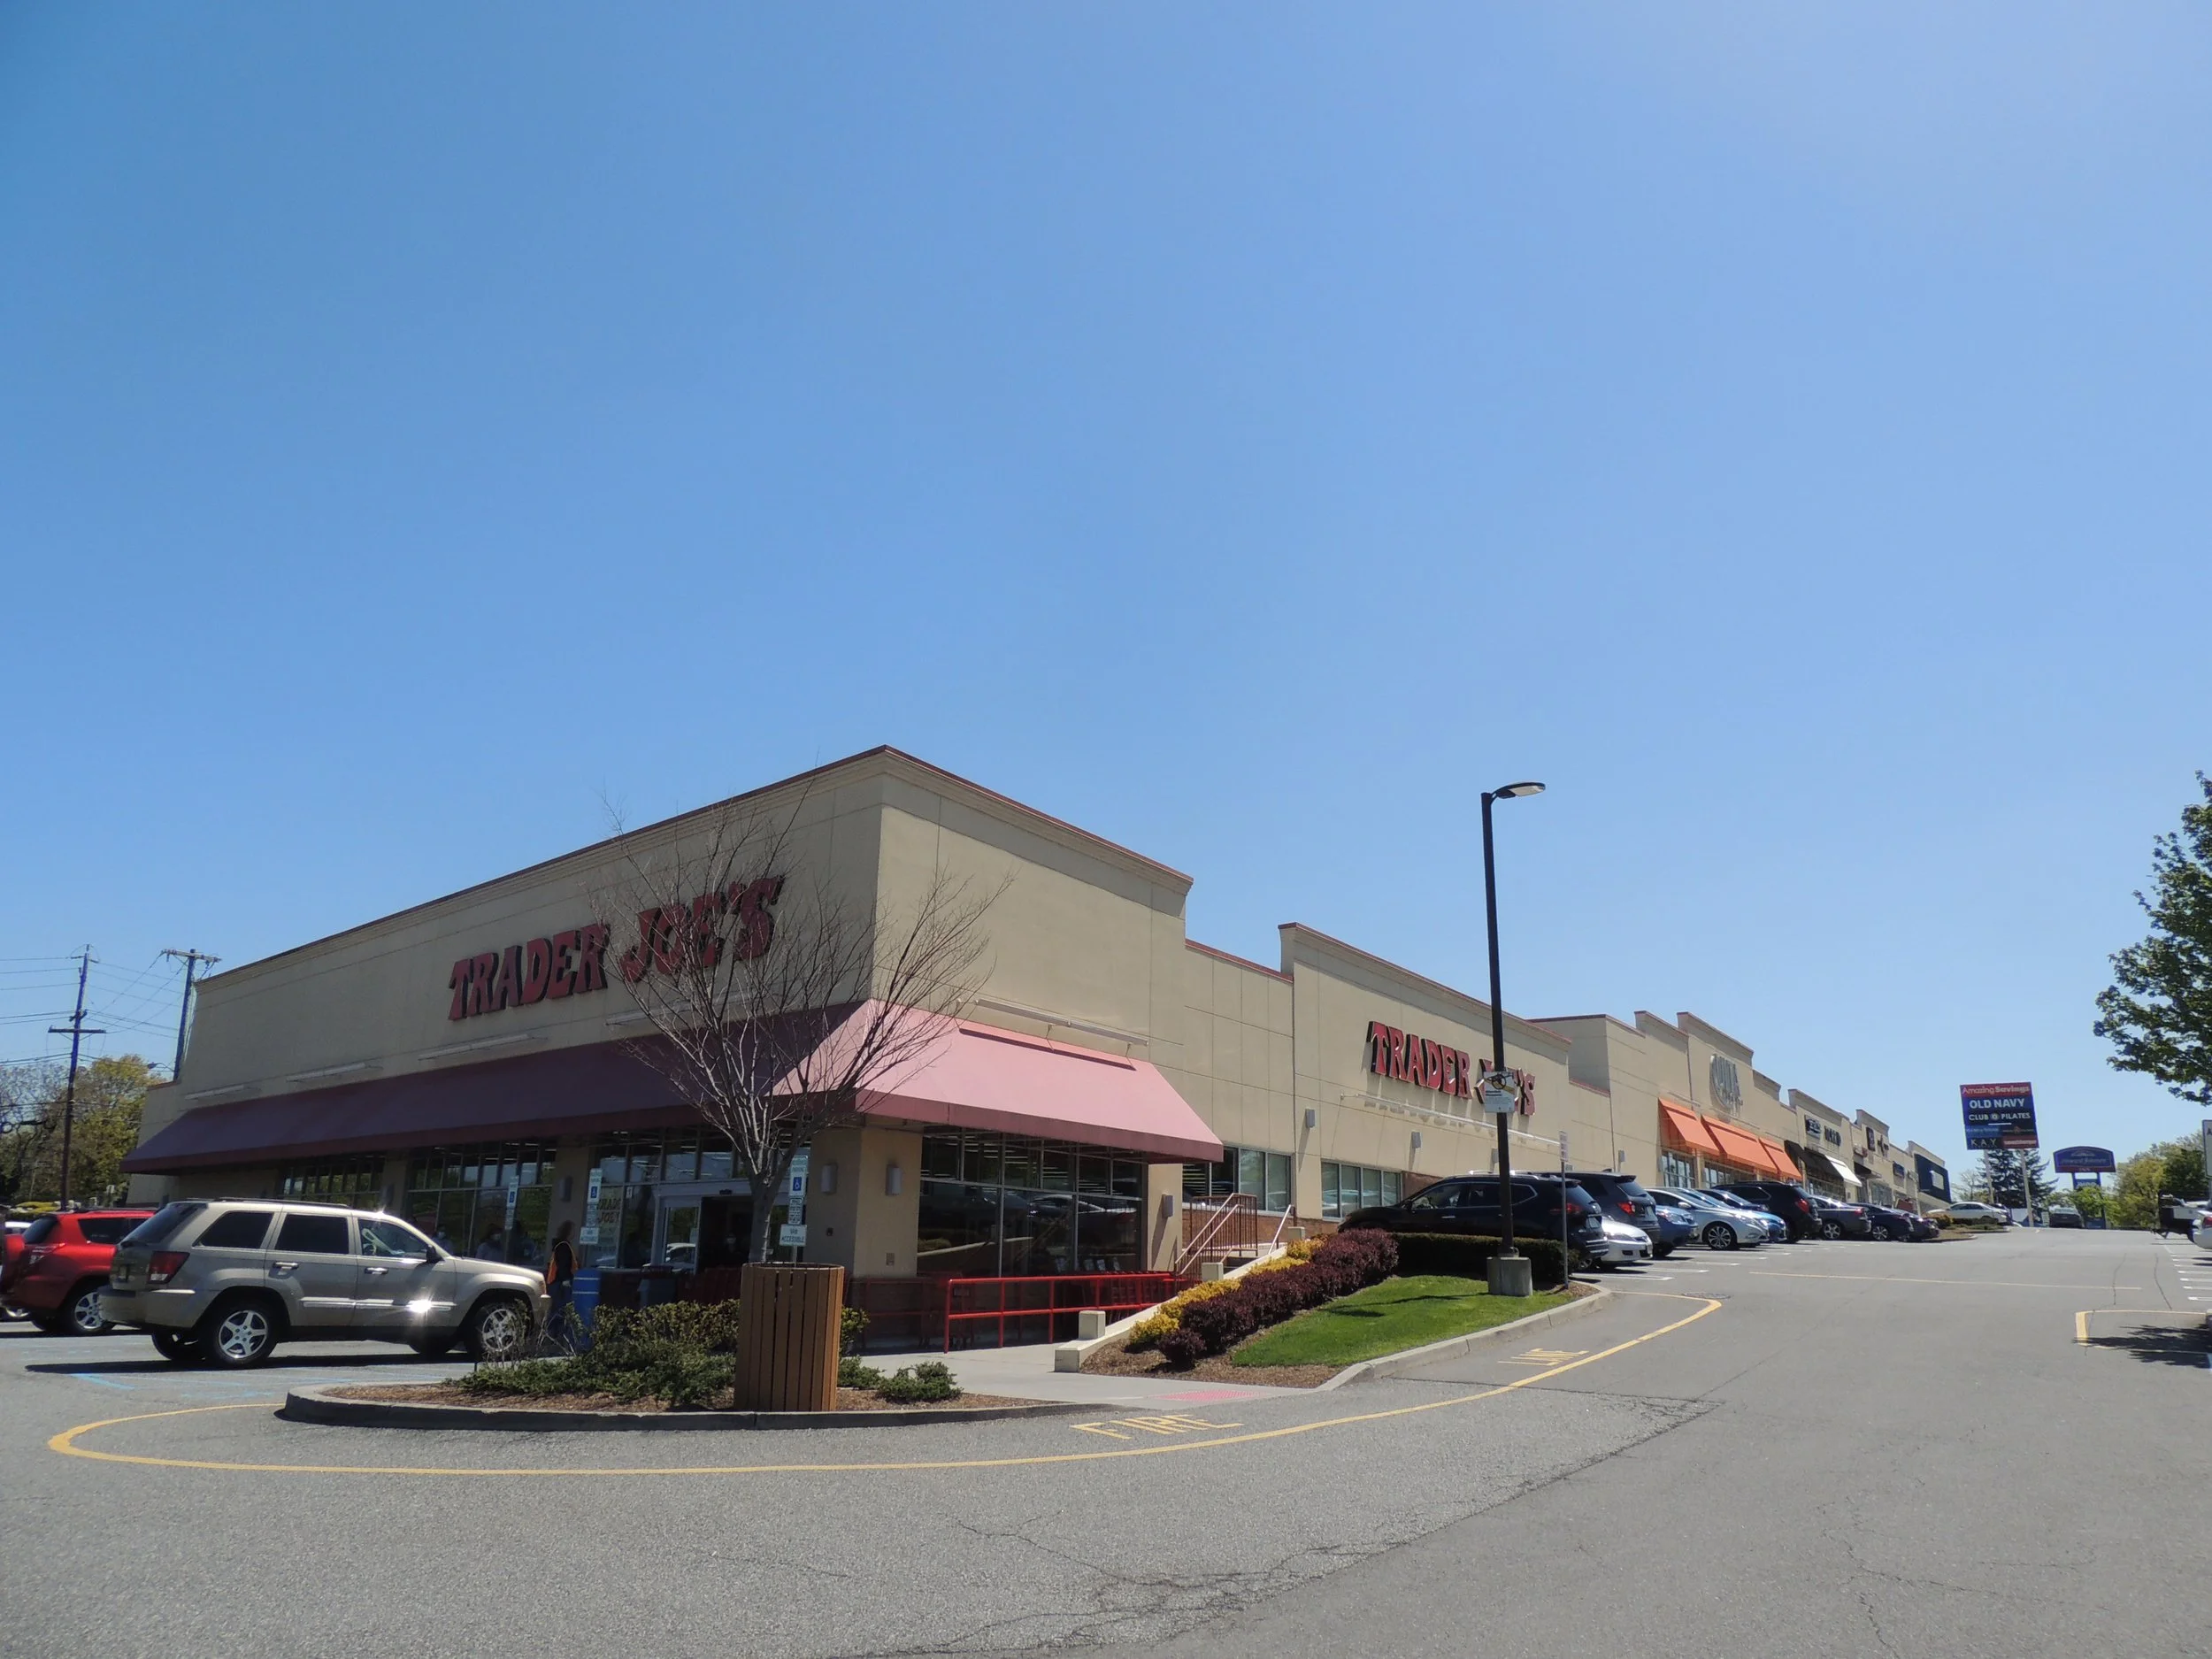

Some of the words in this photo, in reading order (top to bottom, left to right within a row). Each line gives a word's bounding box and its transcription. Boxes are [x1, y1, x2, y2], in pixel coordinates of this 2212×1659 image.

[448, 922, 610, 1021] TRADER
[621, 874, 785, 983] JOE'S
[1366, 1020, 1472, 1100] TRADER
[1962, 1087, 1994, 1095] Amazing
[1994, 1085, 2030, 1094] Savings
[1969, 1099, 1992, 1109] OLD
[1993, 1098, 2025, 1108] NAVY
[1070, 1414, 1245, 1440] FIRE
